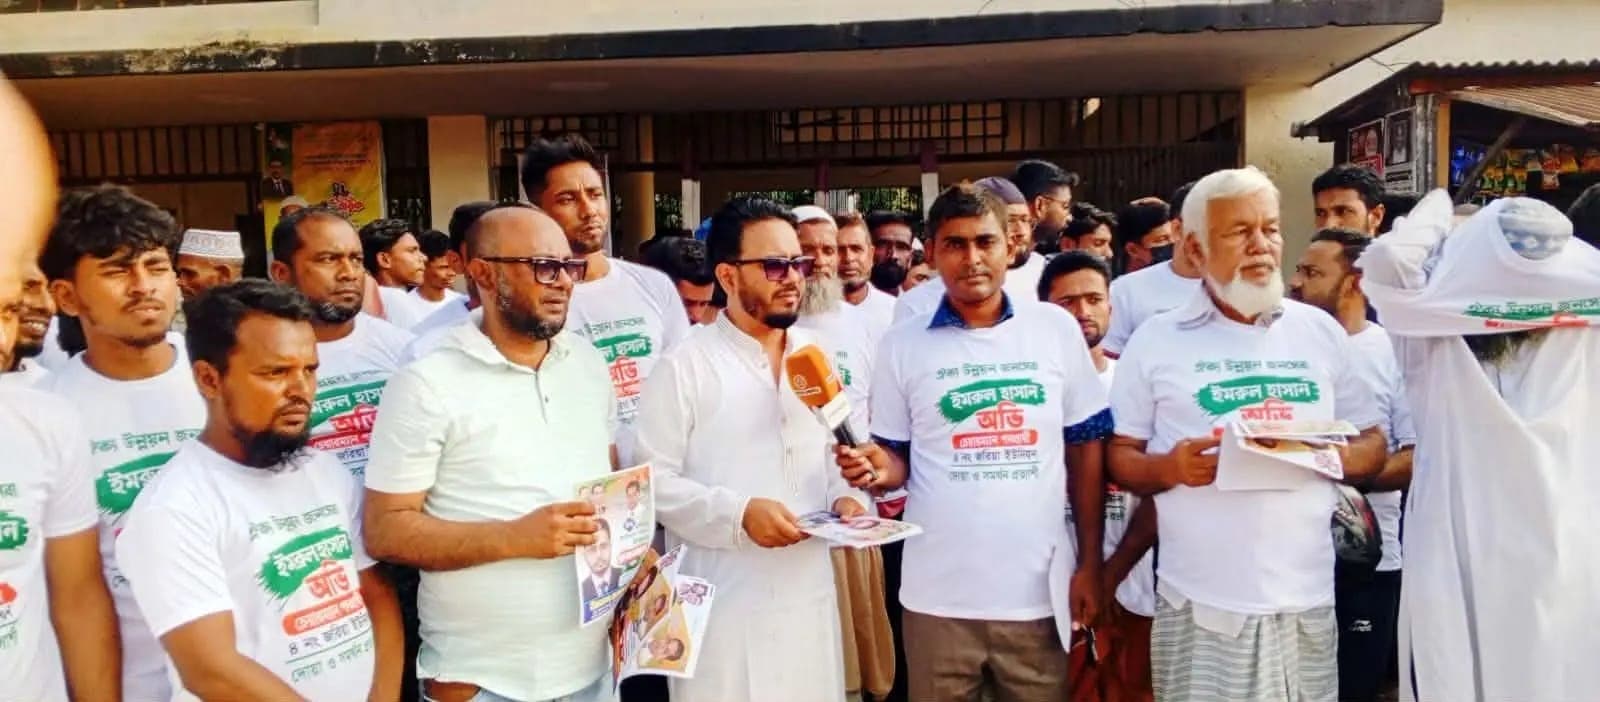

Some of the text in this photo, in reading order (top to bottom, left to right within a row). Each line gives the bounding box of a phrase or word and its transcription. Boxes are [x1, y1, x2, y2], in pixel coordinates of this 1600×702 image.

[950, 384, 1039, 409] ইমরুল হাসান
[976, 400, 1025, 431] অভি
[305, 558, 350, 599] অভি
[288, 641, 299, 656] ৪
